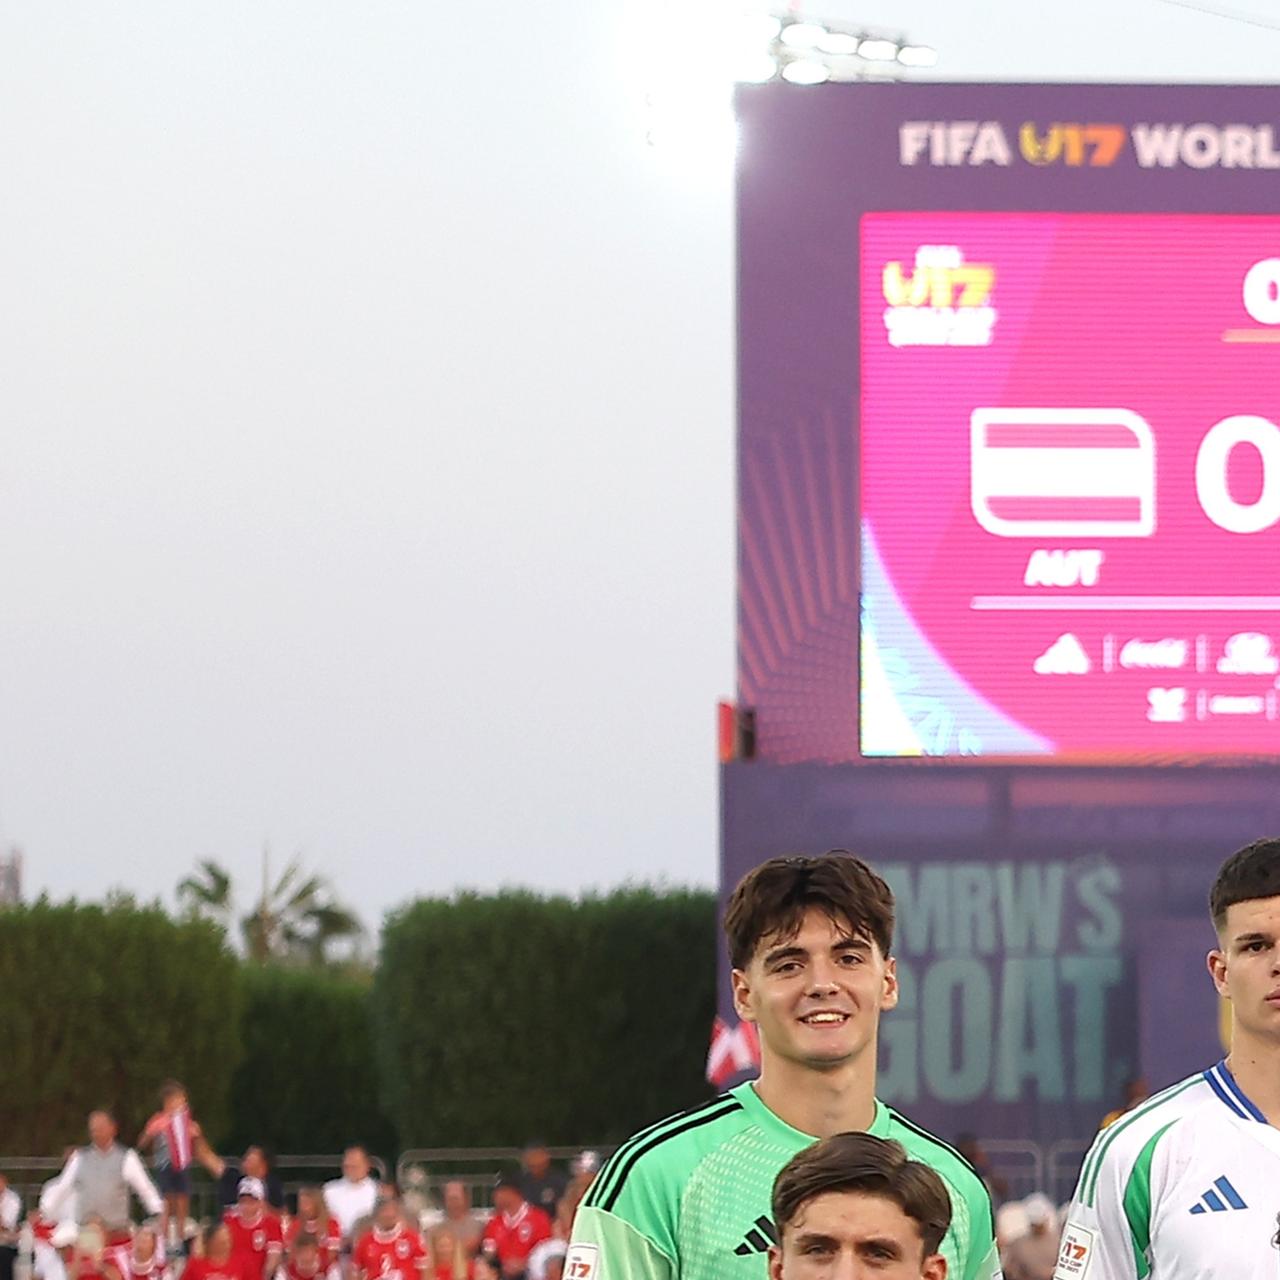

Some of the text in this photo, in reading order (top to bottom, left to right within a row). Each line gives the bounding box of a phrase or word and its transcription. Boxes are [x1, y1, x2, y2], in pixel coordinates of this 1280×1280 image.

[901, 121, 1013, 167] FIFA
[1020, 123, 1125, 167] U17
[1024, 549, 1104, 587] AUT
